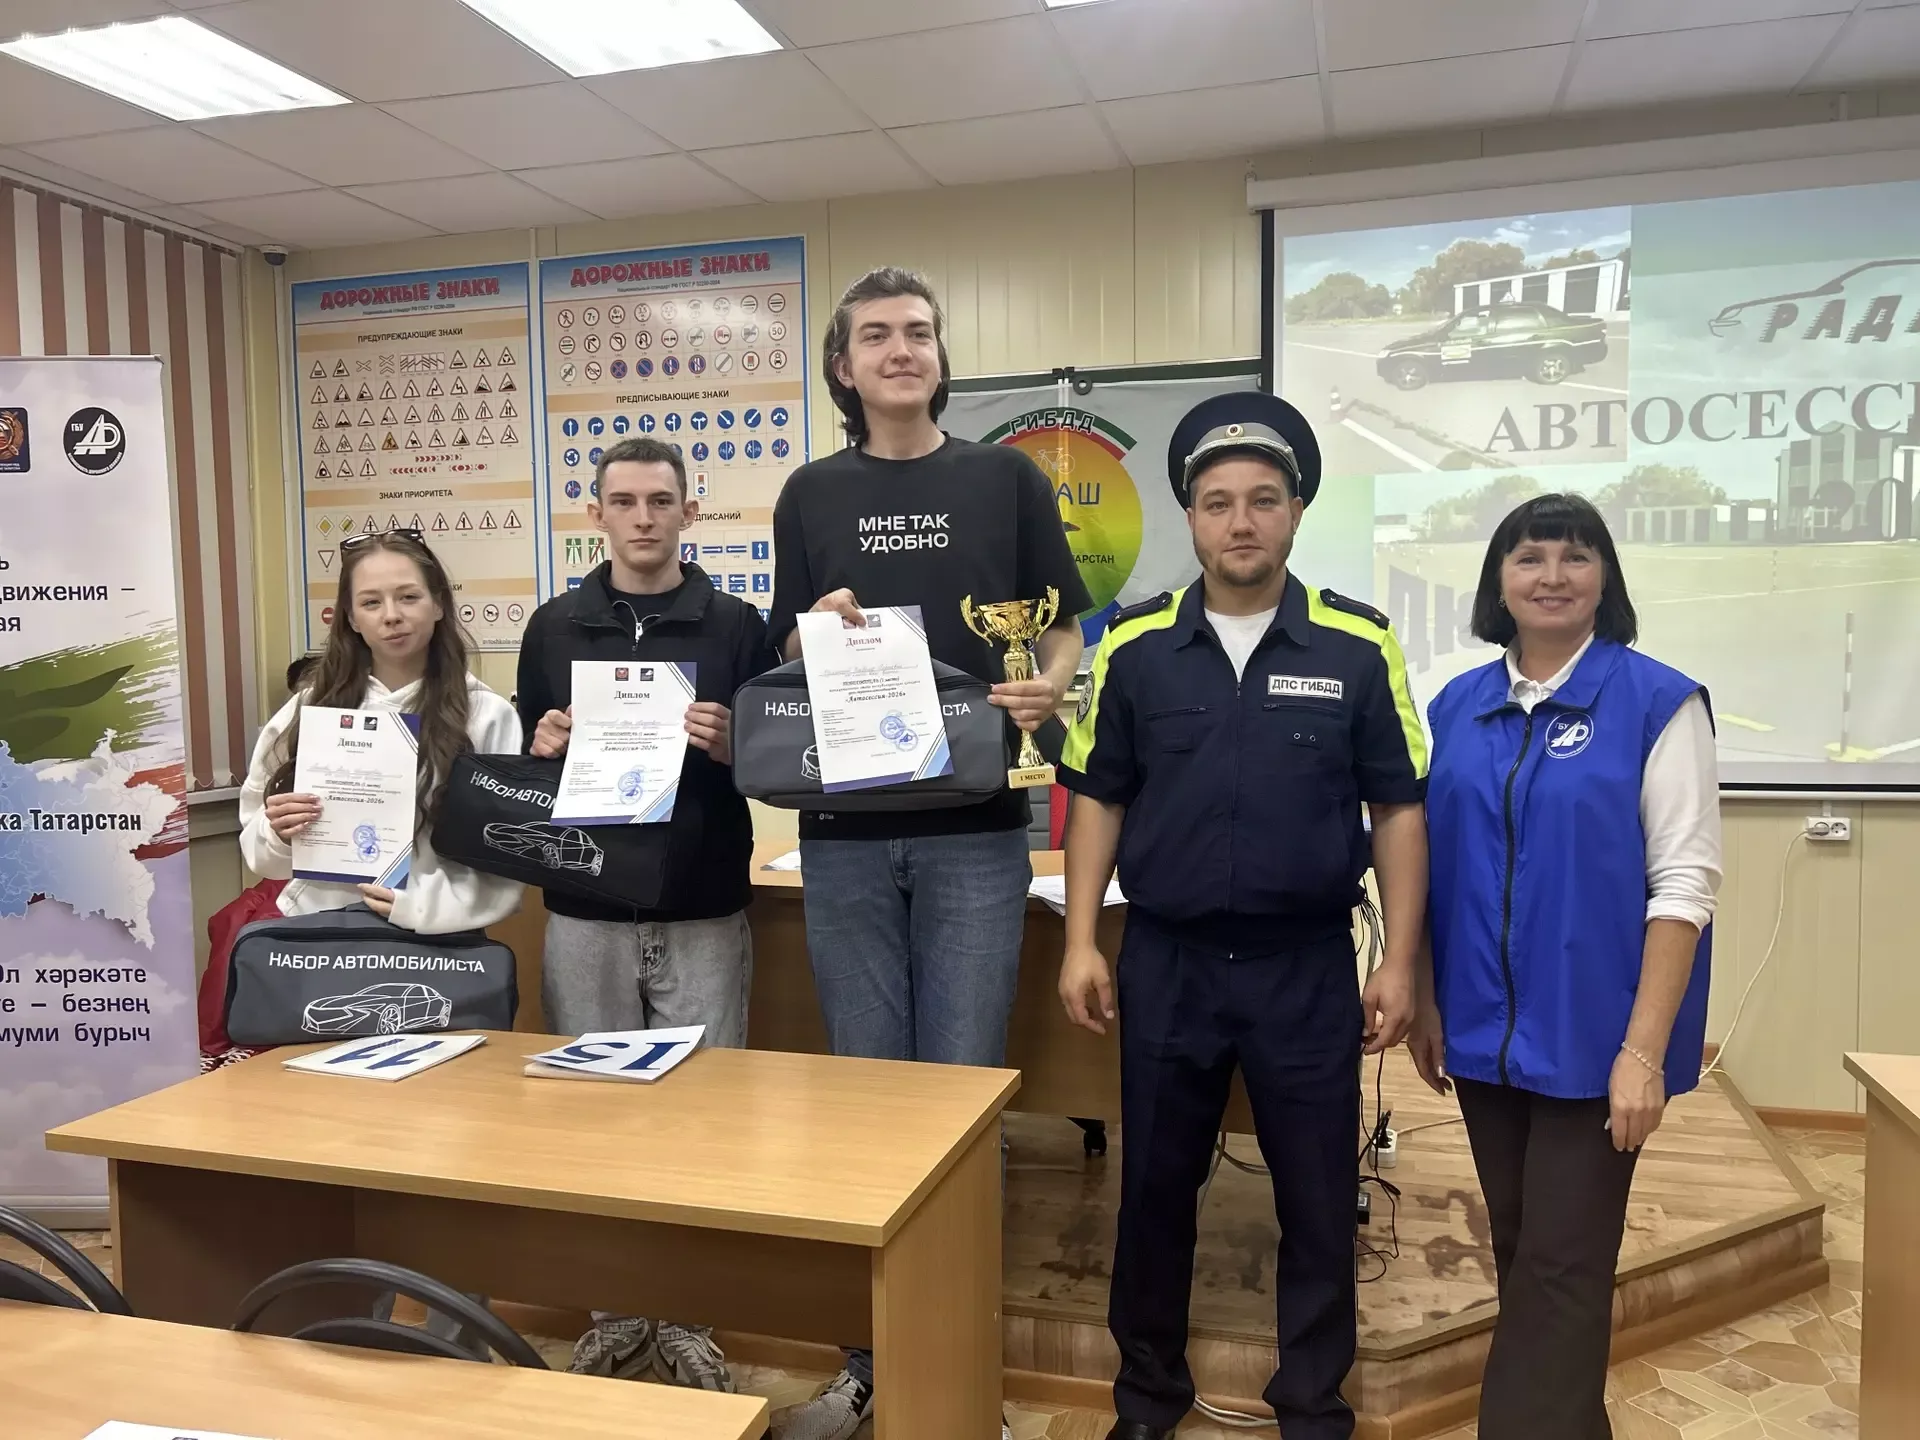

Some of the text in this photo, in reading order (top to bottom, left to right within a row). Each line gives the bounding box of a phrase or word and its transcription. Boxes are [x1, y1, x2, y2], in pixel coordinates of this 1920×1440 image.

[570, 251, 771, 287] ДОРОЖНЫЕ ЗНАКИ
[320, 277, 500, 310] ДОРОЖНЫЕ ЗНАКИ
[357, 327, 463, 344] ПРЕДУПРЕЖДАЮЩИЕ ЗНАКИ
[616, 389, 730, 404] ПРЕДПИСЫВАЮЩИЕ ЗНАКИ
[71, 423, 84, 432] ГБУ
[1009, 411, 1095, 435] ГИБДД
[379, 489, 453, 500] ЗНАКИ ПРИОРИТЕТА
[1056, 482, 1100, 505] АШ
[695, 510, 741, 522] ДПИСАНИЙ
[859, 513, 950, 532] МНЕ ТАК
[859, 532, 949, 554] УДОБНО
[1073, 554, 1115, 564] АРСТАН
[0, 585, 108, 604] вижения
[845, 636, 882, 648] Диплом
[614, 690, 650, 700] Диплом
[1272, 678, 1341, 696] ДПС ГИБДД
[765, 702, 972, 717] НАБО СТА
[337, 737, 373, 749] Диплом
[470, 771, 516, 798] НАБОР
[29, 808, 142, 835] Татарстан
[269, 952, 485, 973] НАБОР АВТОМОБИЛИСТА
[35, 968, 147, 989] хәрәкәте
[62, 993, 151, 1014] безнең
[74, 1022, 150, 1047] бурыч
[541, 1040, 691, 1071] 15
